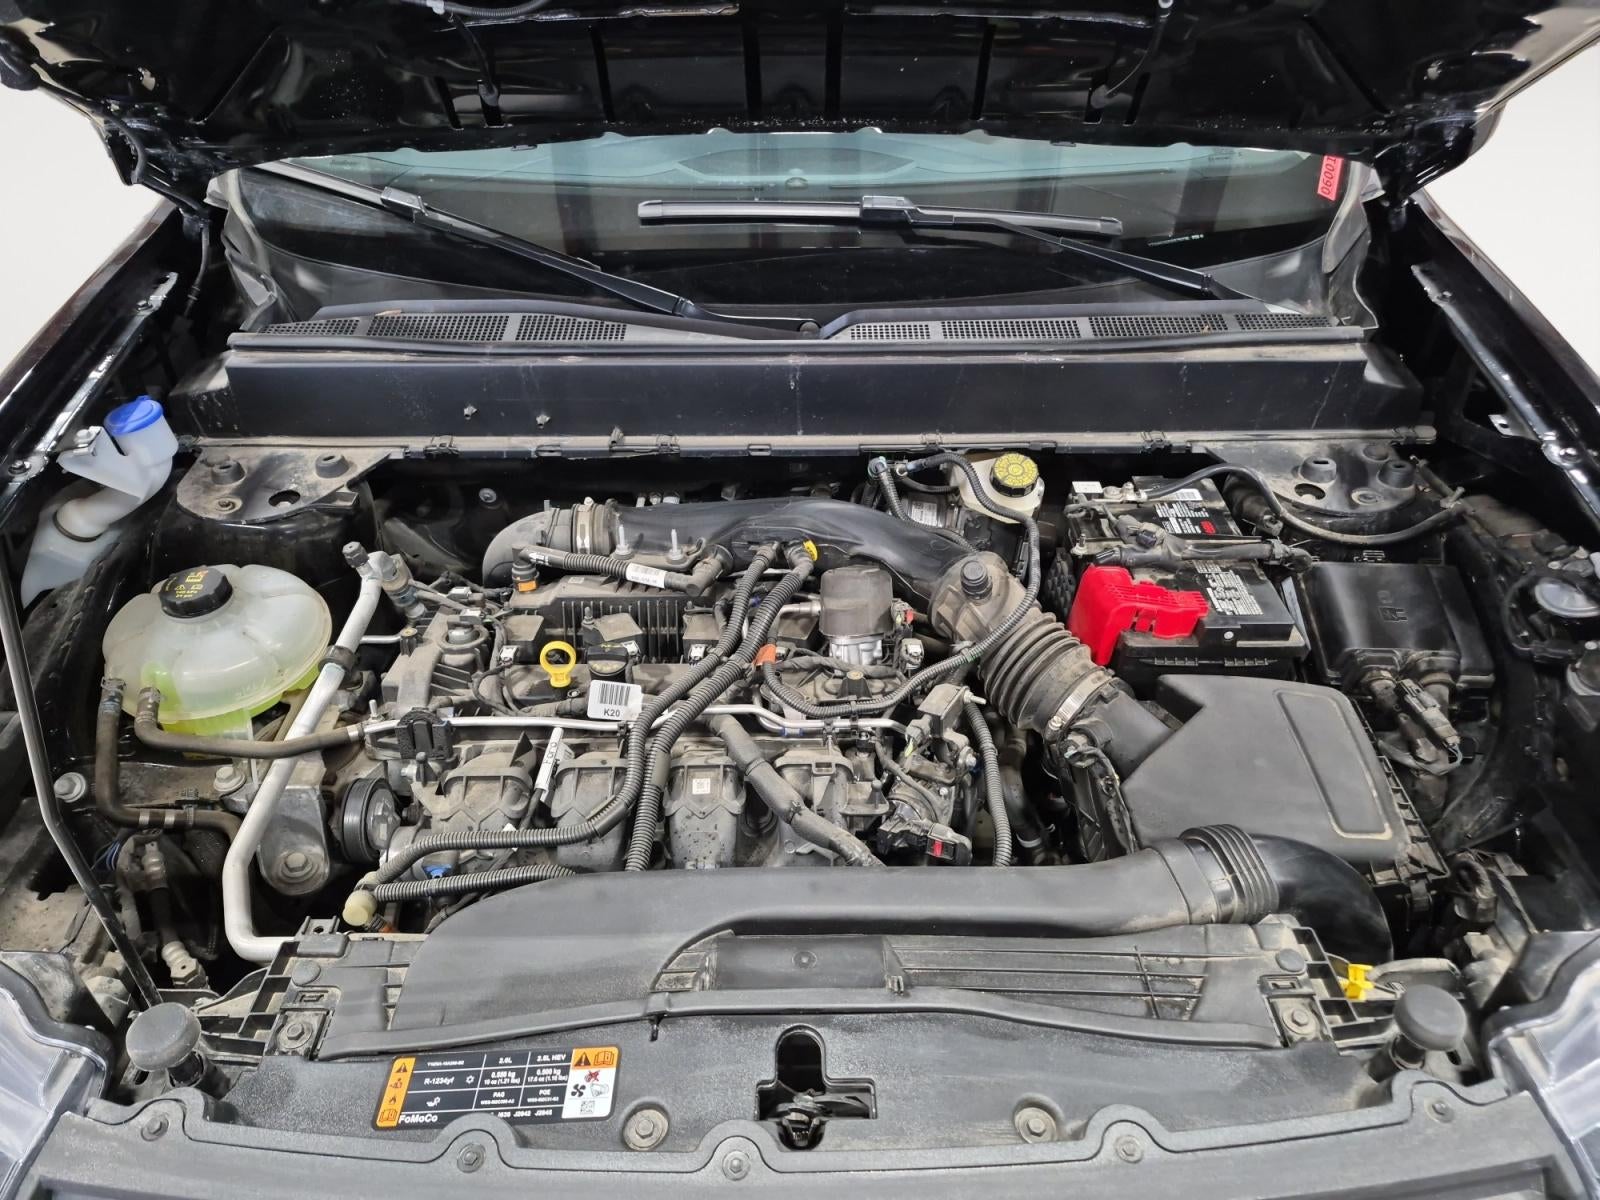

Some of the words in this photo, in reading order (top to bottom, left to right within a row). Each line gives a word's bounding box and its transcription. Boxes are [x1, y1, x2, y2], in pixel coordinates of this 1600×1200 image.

[1320, 157, 1336, 195] 06001
[603, 708, 621, 718] K20
[551, 1053, 567, 1061] HEV
[507, 1070, 516, 1080] kg
[553, 1067, 562, 1077] kg
[423, 1076, 455, 1086] R-1234yf
[398, 1113, 438, 1124] FoMoCo
